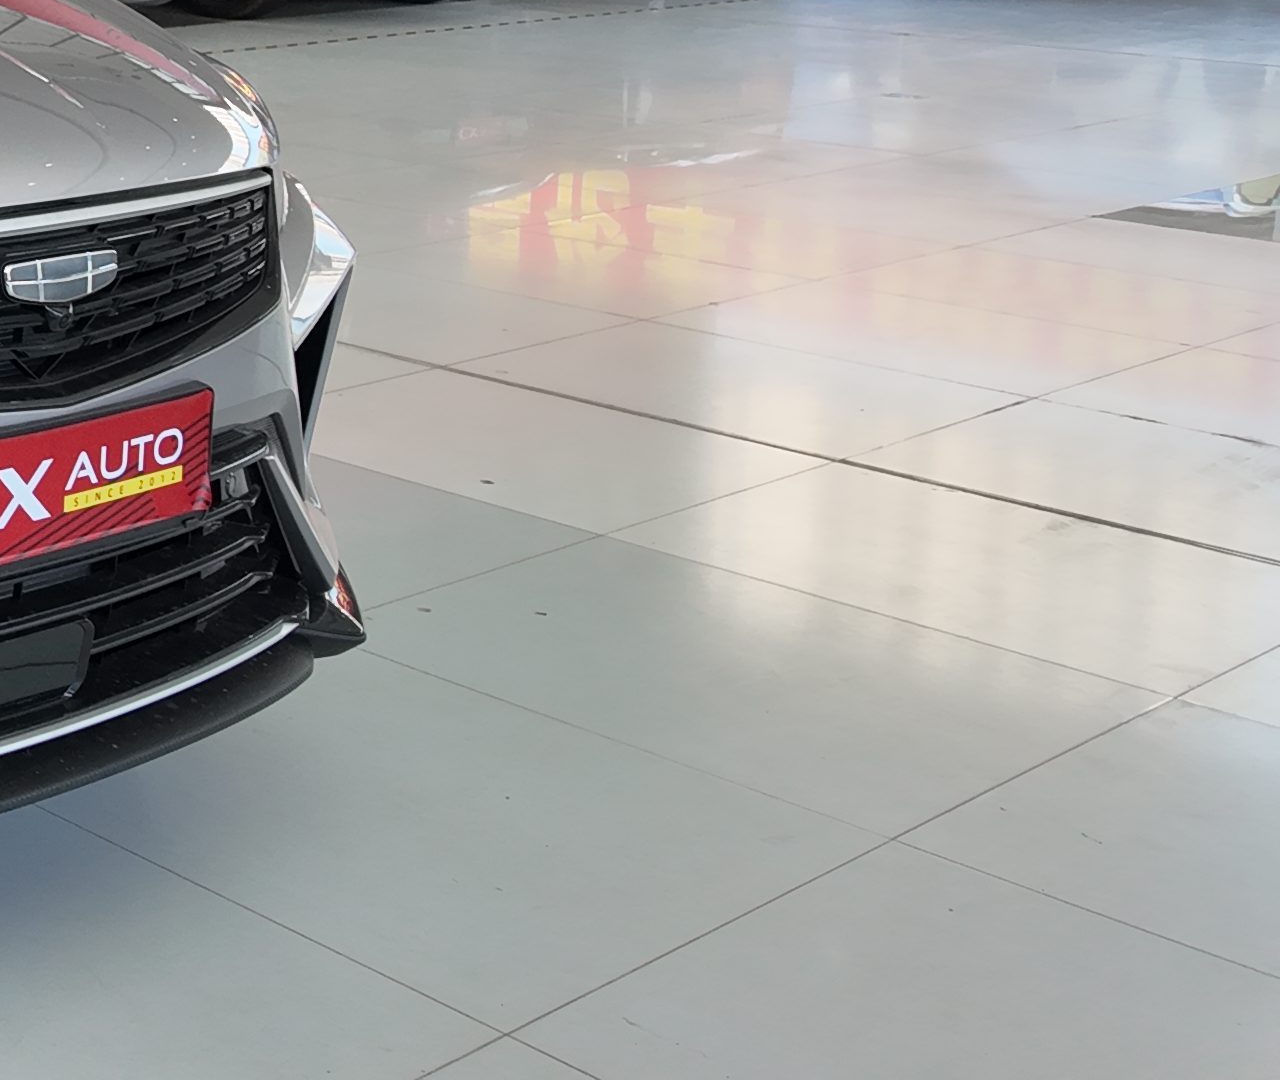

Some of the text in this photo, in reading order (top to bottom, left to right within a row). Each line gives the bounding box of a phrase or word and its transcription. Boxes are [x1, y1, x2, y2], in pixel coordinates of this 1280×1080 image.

[64, 428, 184, 491] AUTO
[73, 470, 177, 508] SINCE 2012
